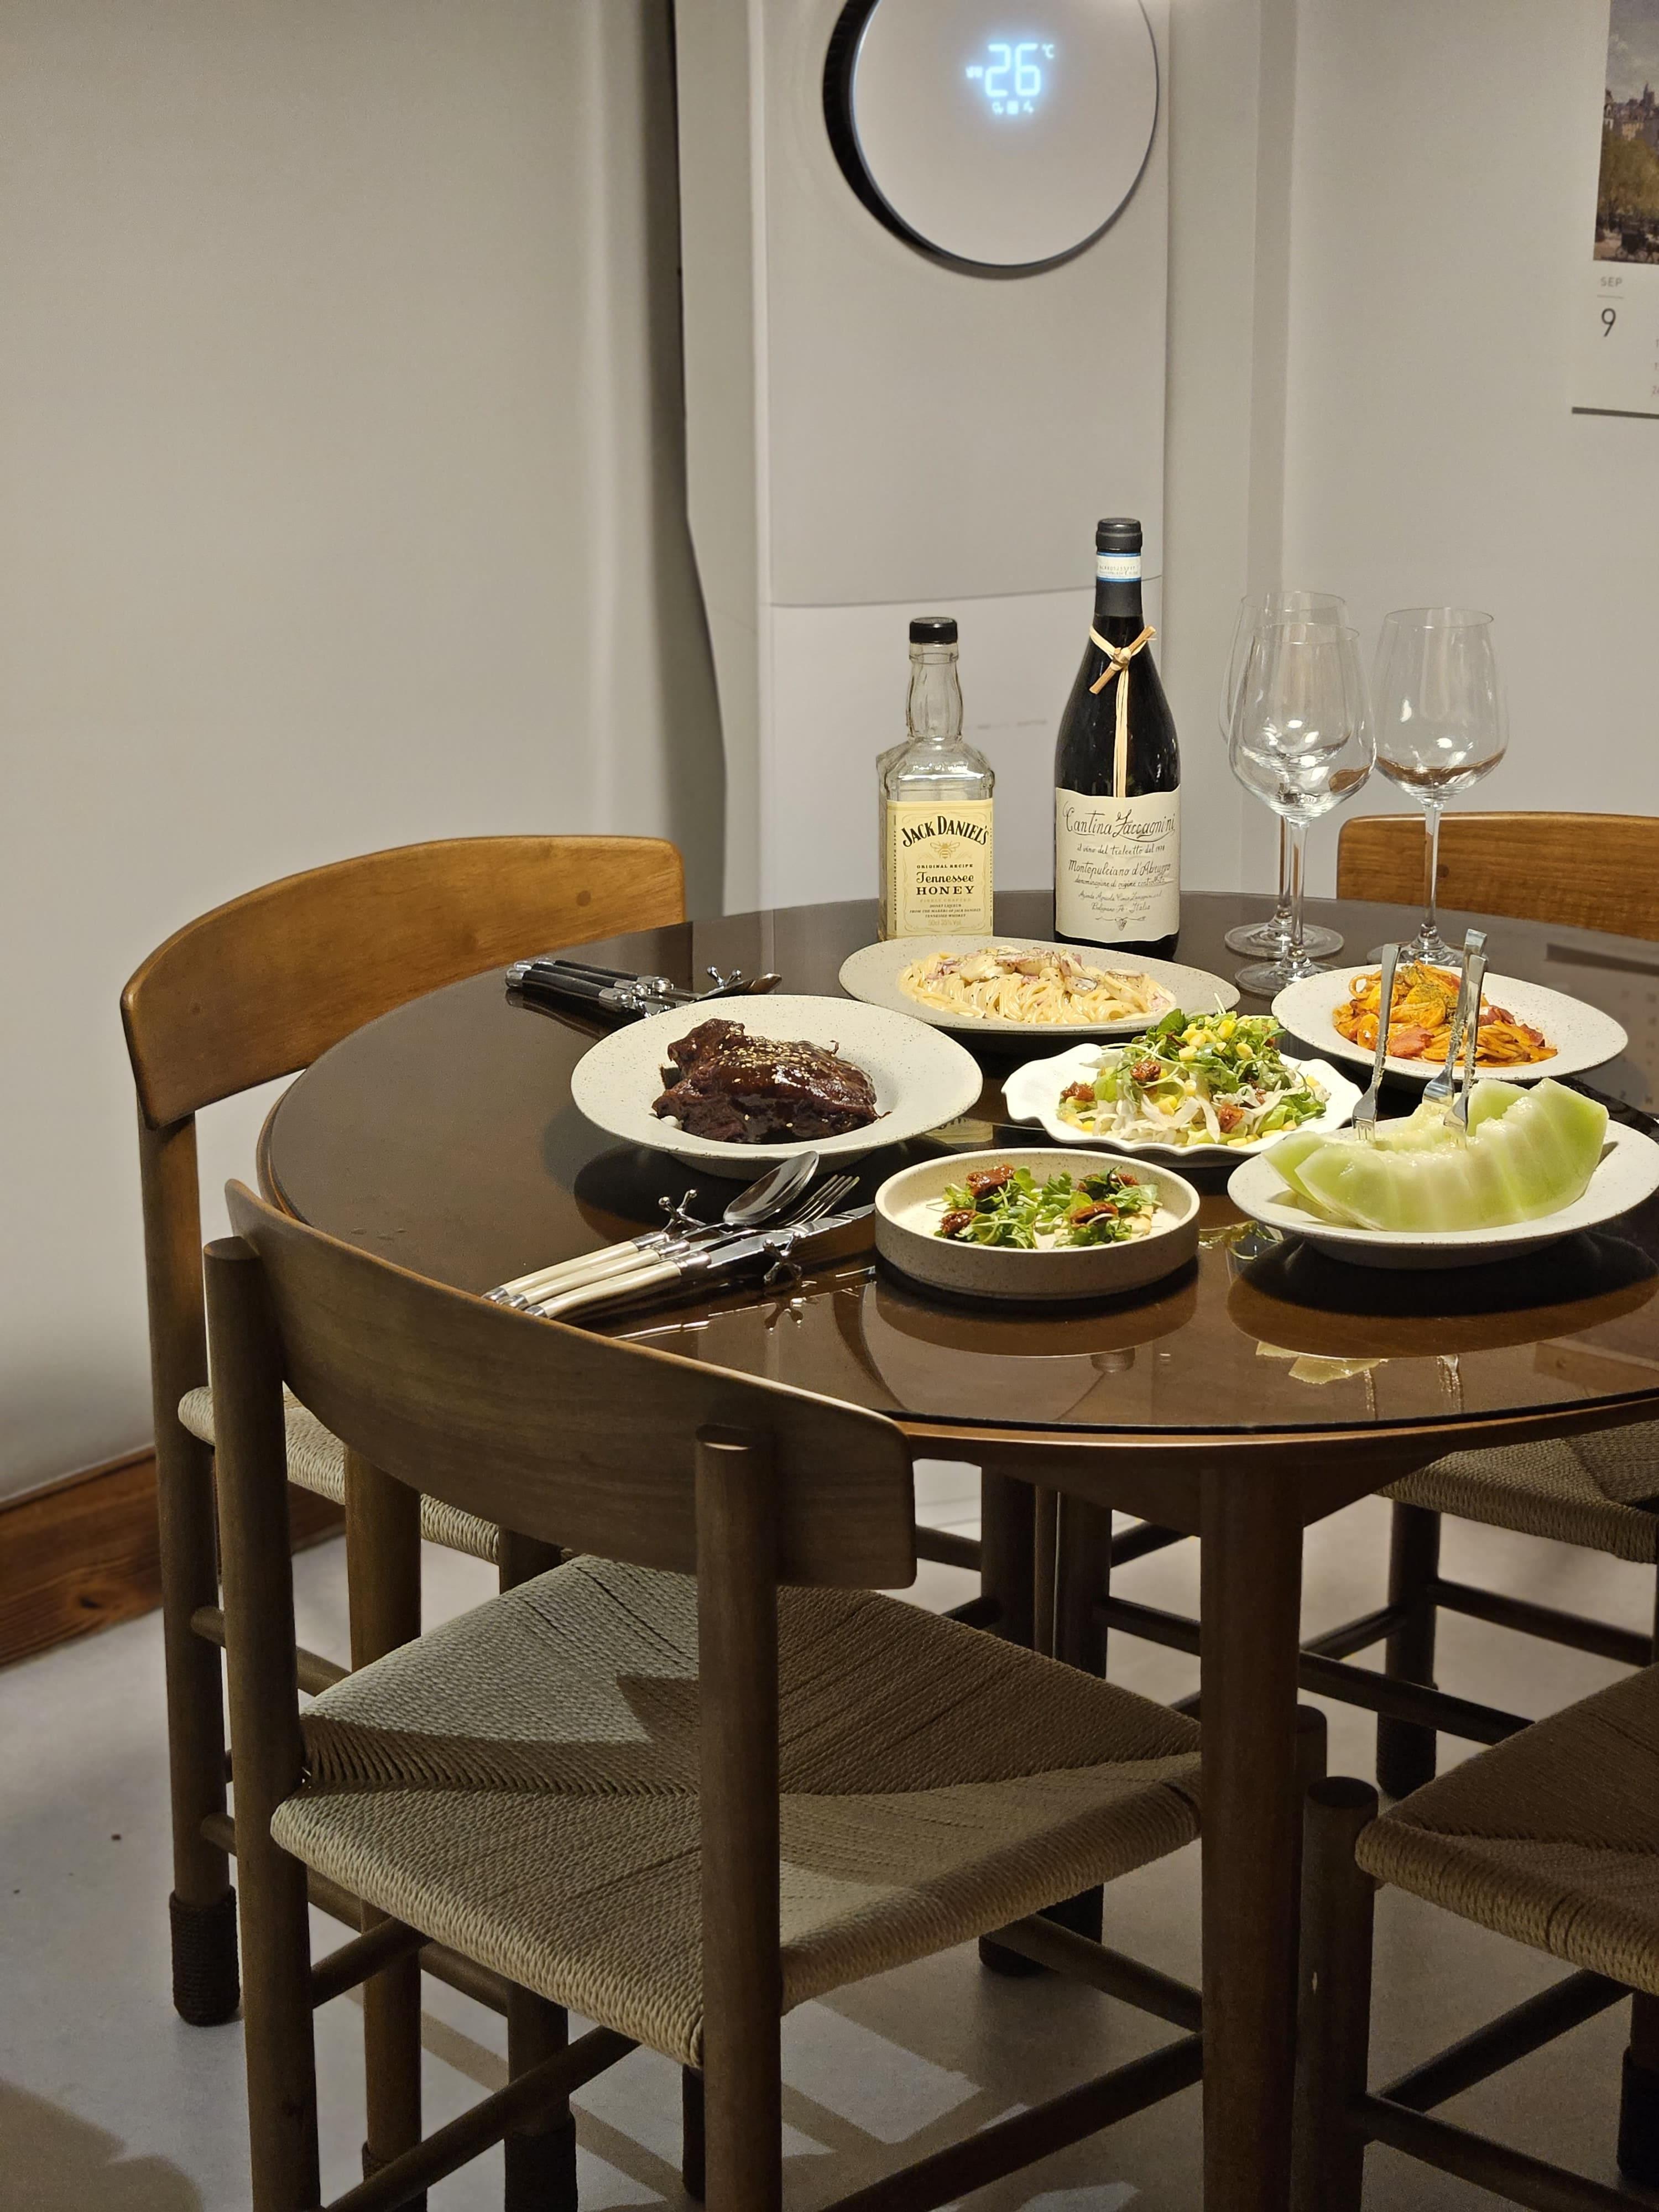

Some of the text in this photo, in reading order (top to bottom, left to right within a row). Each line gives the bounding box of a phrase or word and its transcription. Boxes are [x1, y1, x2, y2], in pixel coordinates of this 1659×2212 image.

[1600, 276, 1623, 288] SEP
[1601, 307, 1616, 338] 9
[1062, 801, 1176, 843] Cantina Zaccagnini
[901, 816, 989, 847] JACK DANIEL'S
[1098, 844, 1108, 854] del
[1068, 859, 1129, 879] Montepulciano
[916, 872, 974, 884] Tennessee
[916, 886, 974, 895] HONEY
